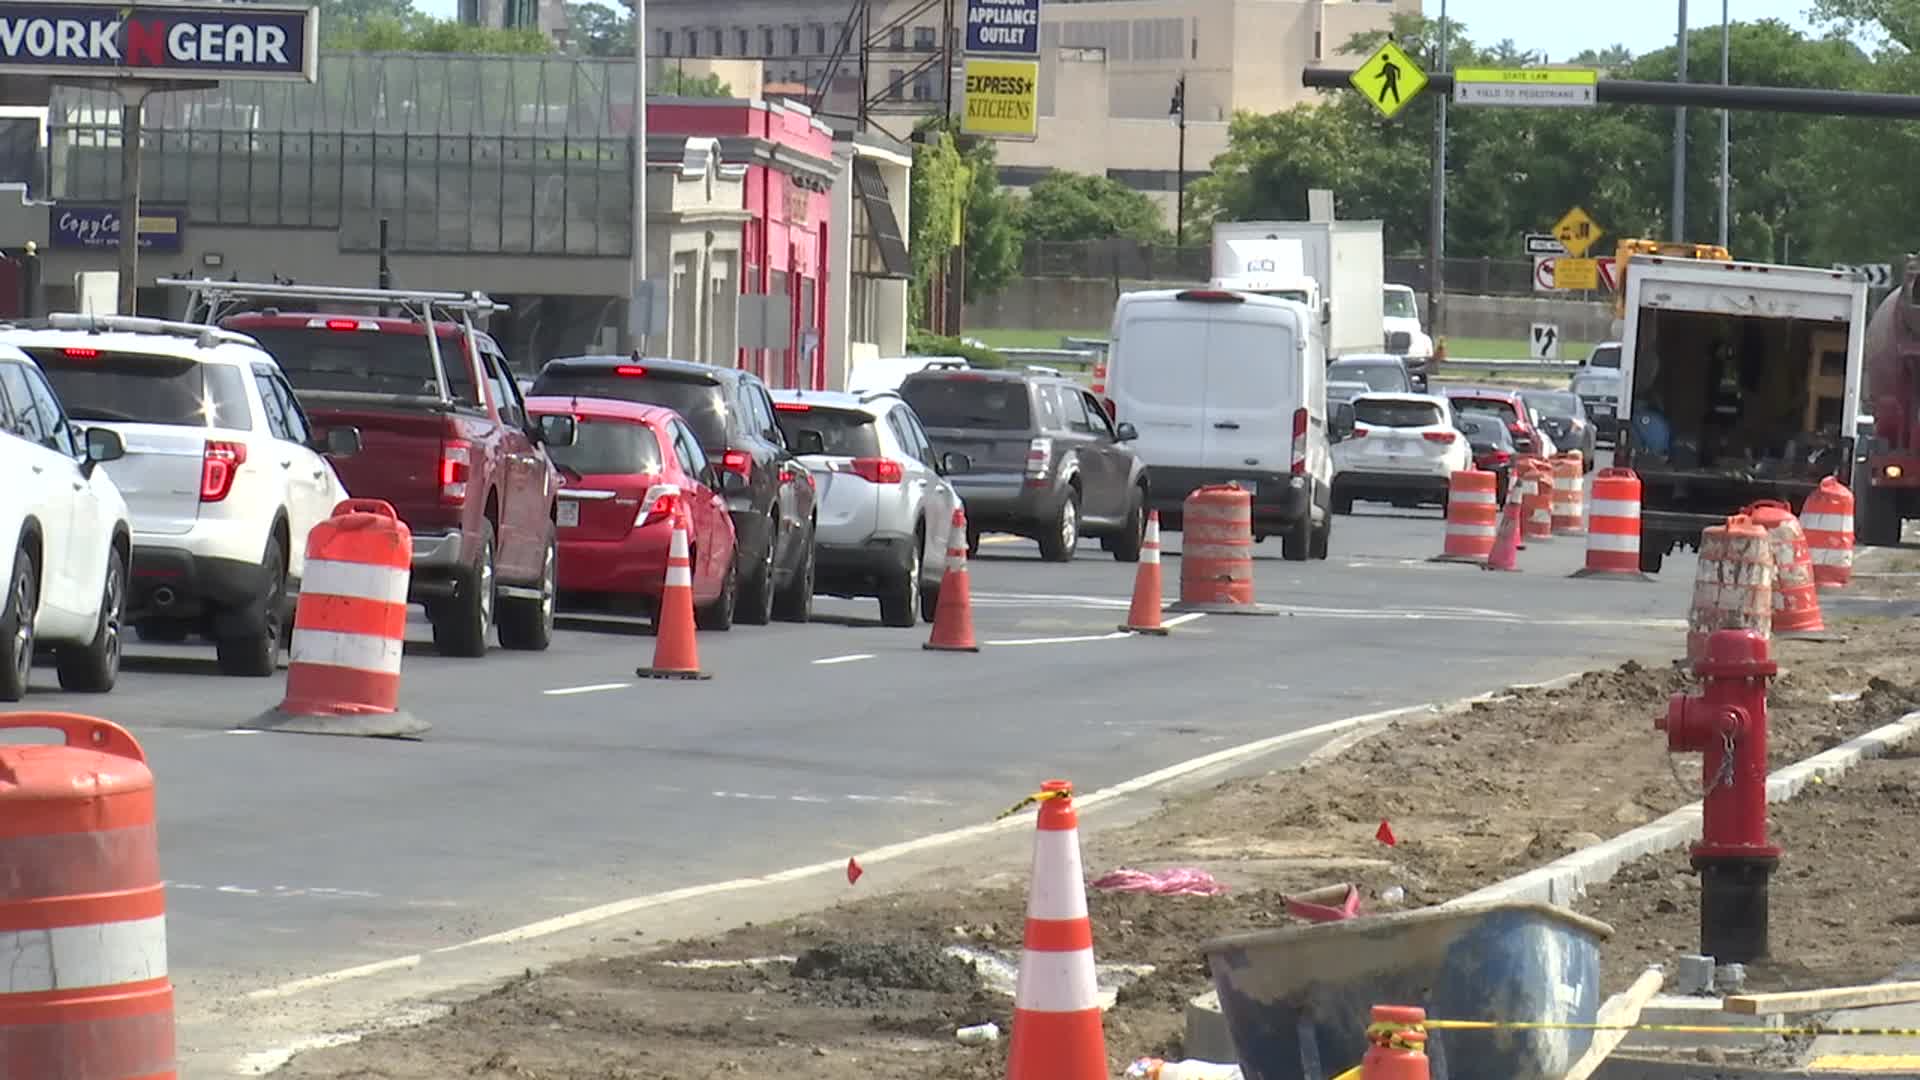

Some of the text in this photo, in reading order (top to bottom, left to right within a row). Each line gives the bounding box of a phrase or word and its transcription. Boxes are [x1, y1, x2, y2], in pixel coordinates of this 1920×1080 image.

[969, 7, 1036, 25] APPLIANCE
[127, 19, 166, 66] N
[168, 22, 289, 64] GEAR
[980, 26, 1025, 45] OUTLET
[966, 75, 1025, 95] EXPRESS
[1503, 72, 1548, 80] STATE LAW
[1476, 88, 1574, 98] YIELD TO PEDESTRIANS
[968, 98, 1031, 120] KITCHENS
[60, 211, 120, 239] CopyCa
